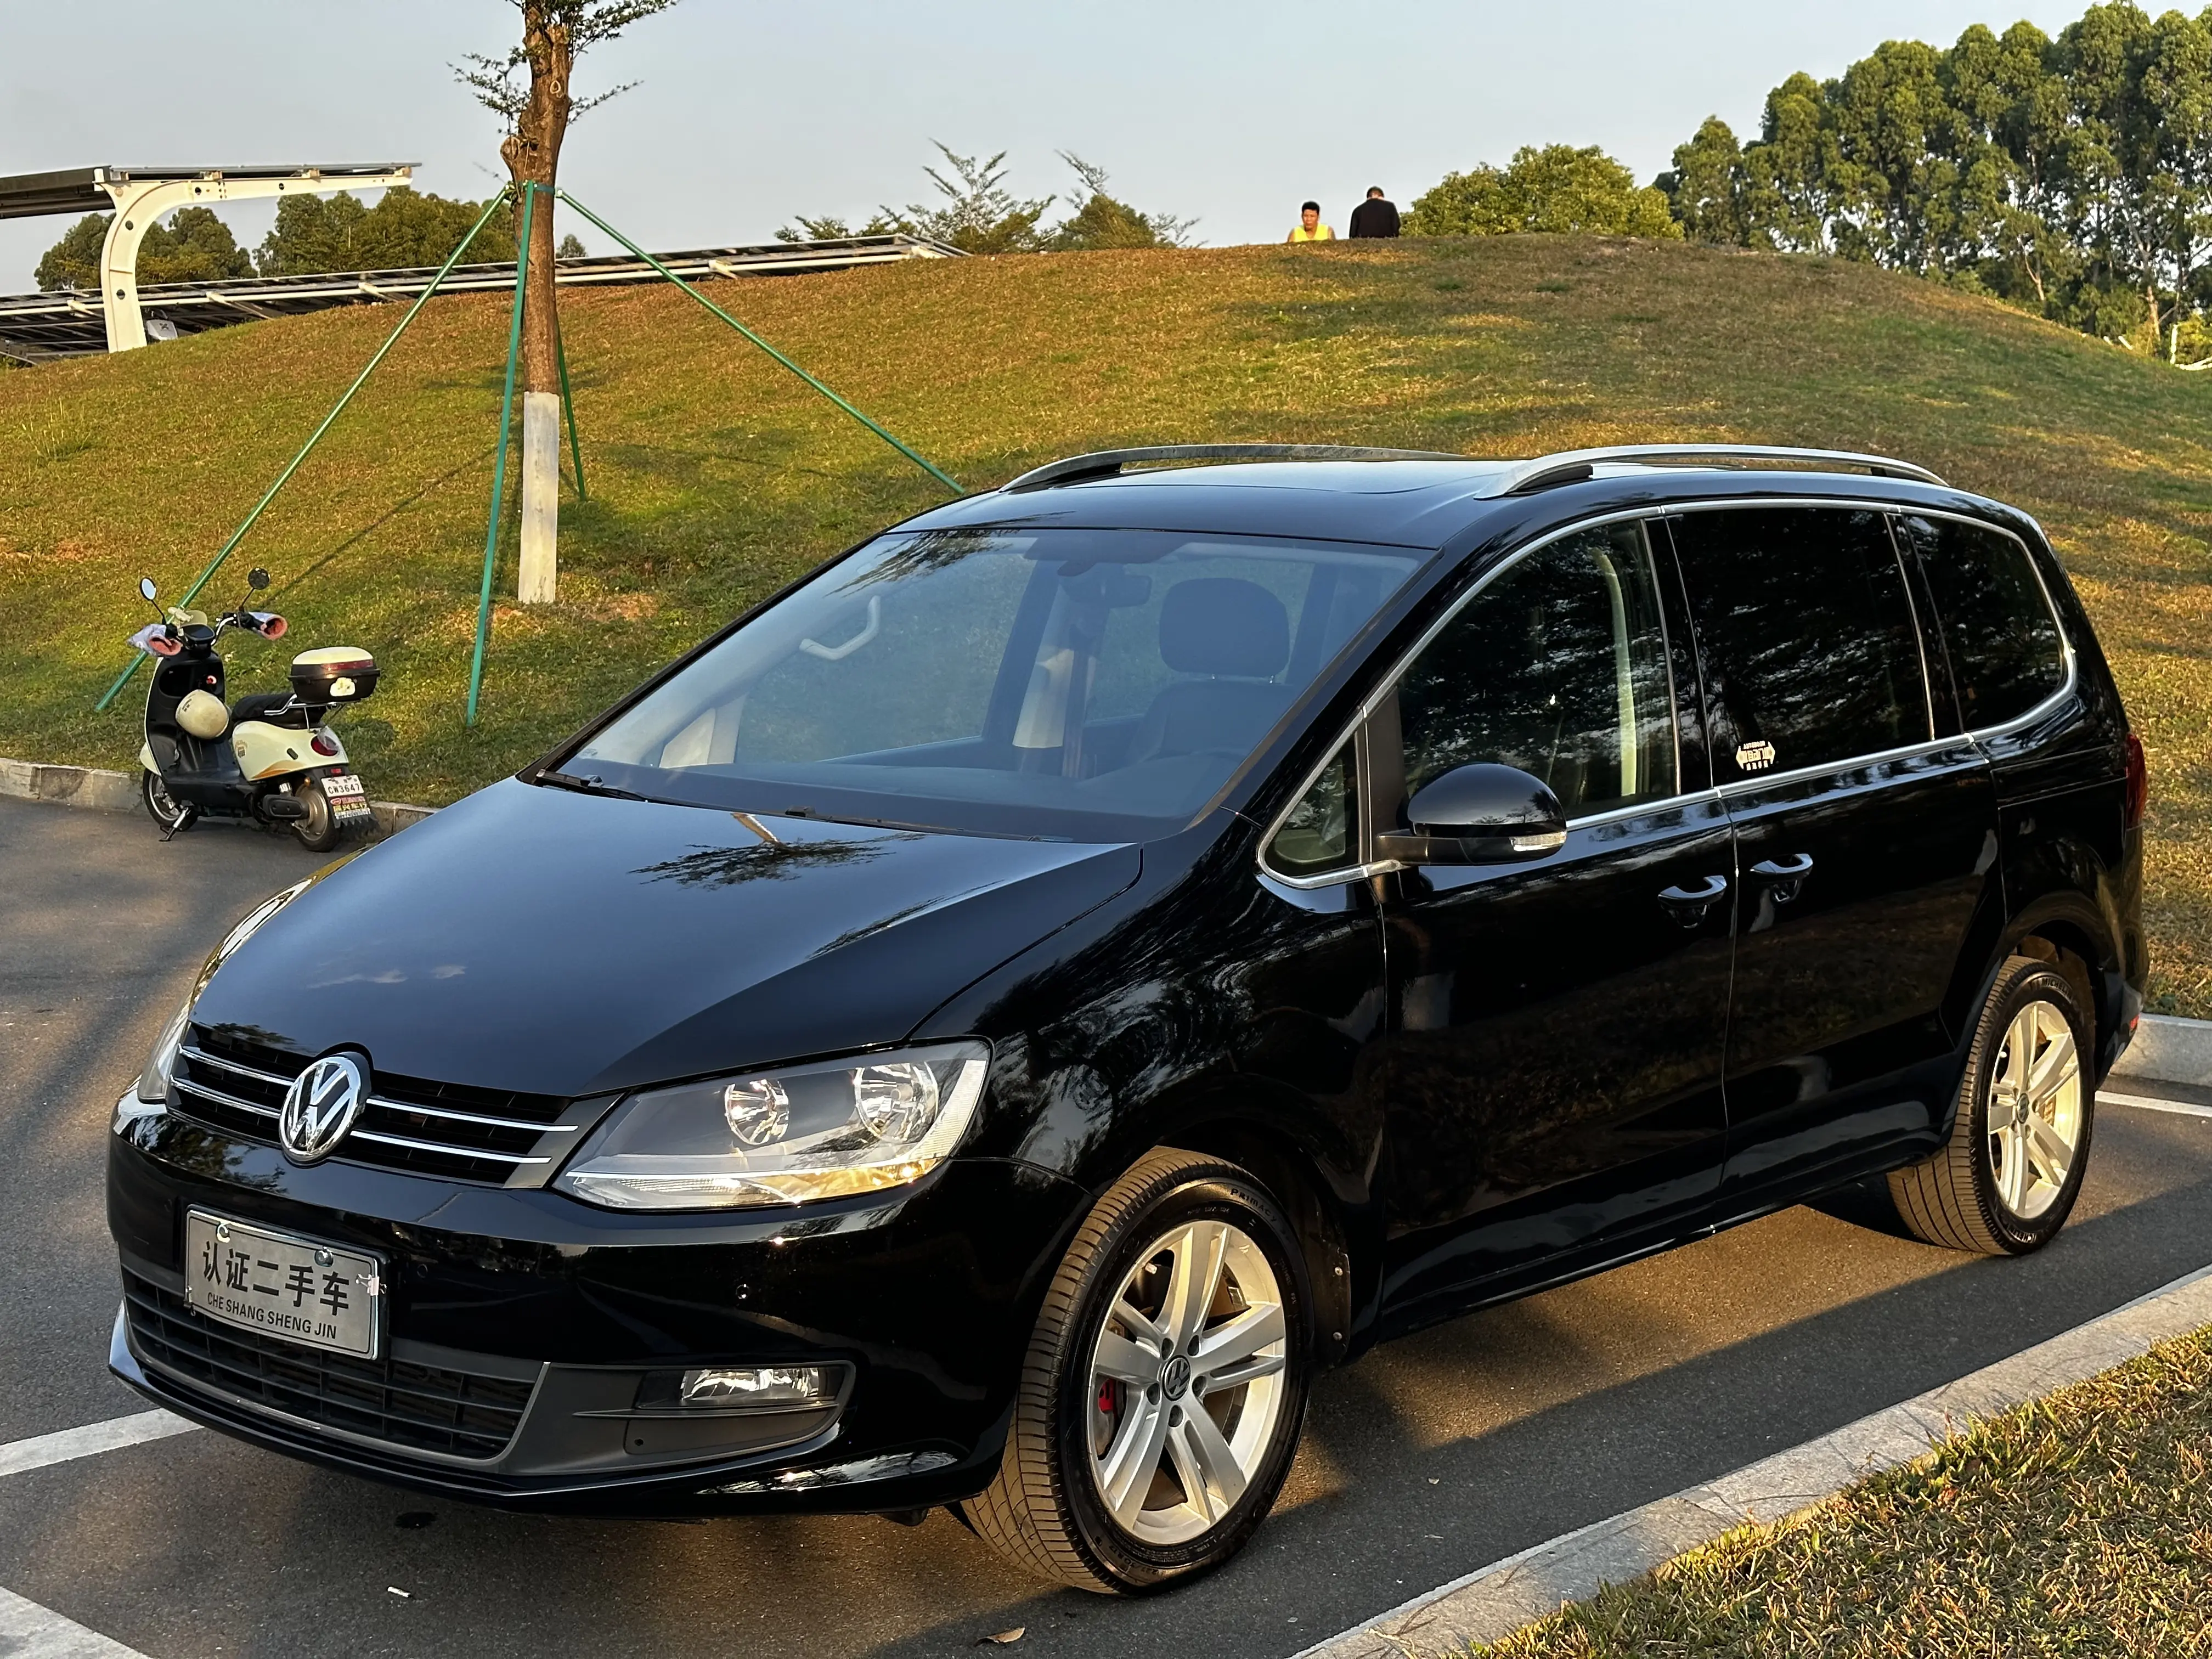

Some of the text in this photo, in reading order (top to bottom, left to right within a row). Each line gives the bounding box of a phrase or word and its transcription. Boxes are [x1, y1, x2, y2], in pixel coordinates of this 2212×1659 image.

[328, 783, 360, 794] CW3647
[1231, 1188, 1277, 1222] PRIMACY
[203, 1241, 349, 1316] 认证二手车
[207, 1291, 337, 1339] CHE SHANG SHENG JIN
